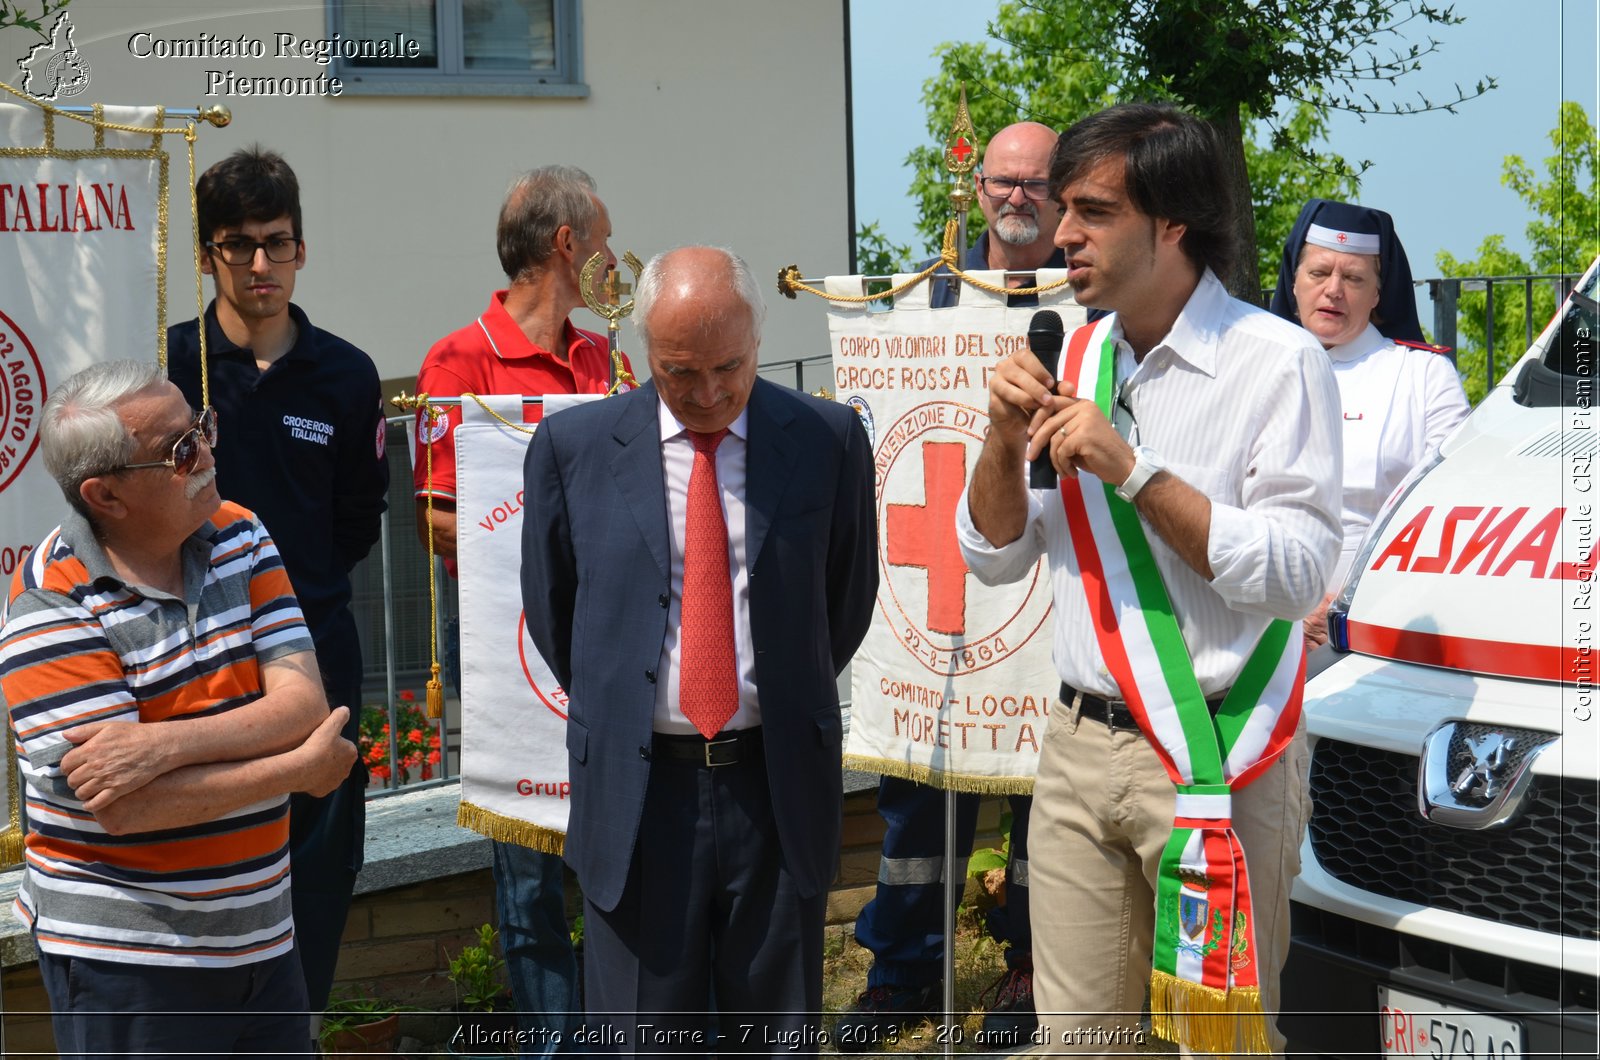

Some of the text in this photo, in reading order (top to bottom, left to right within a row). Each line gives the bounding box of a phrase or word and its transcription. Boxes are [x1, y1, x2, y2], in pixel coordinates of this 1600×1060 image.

[840, 335, 880, 359] CORPO
[885, 335, 946, 359] VOLONTARI
[955, 333, 989, 357] DEL
[836, 366, 896, 390] CROCE
[901, 366, 970, 390] ROSSA
[8, 360, 34, 442] AGOSTO
[953, 408, 977, 429] DI
[291, 427, 328, 446] ITALIANA
[0, 443, 17, 476] 18
[880, 677, 943, 711] COMITATO
[893, 707, 1039, 753] MORETTA
[516, 778, 570, 800] Grup
[1381, 1005, 1416, 1057] CRI
[1430, 1018, 1475, 1060] 579
